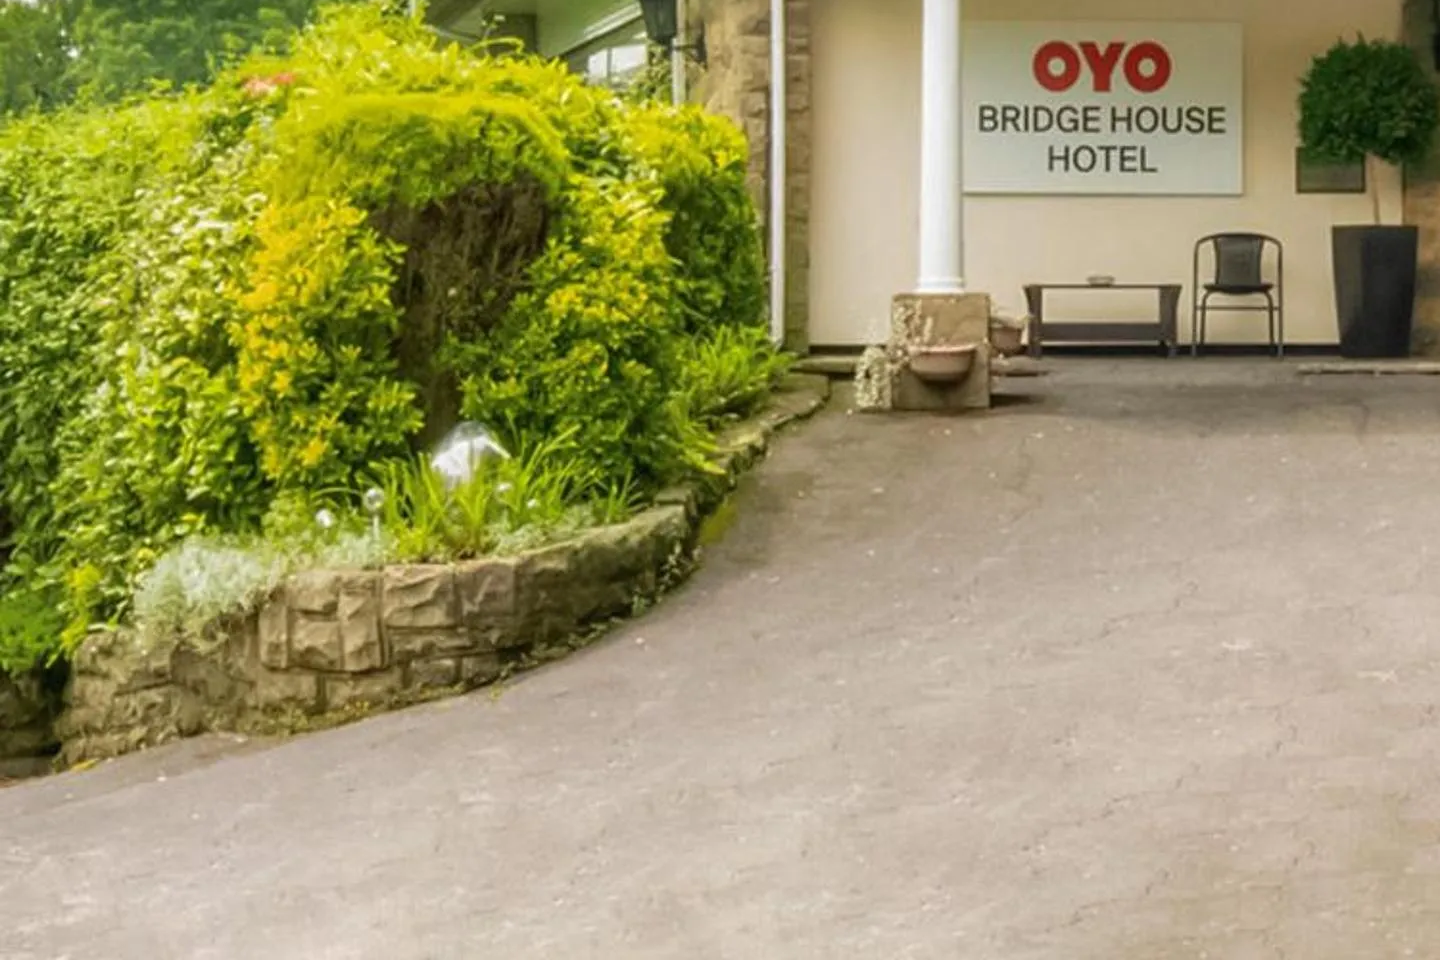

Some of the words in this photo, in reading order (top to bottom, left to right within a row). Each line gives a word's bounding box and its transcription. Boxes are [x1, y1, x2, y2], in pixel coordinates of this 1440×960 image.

[1033, 41, 1171, 92] OYO
[978, 105, 1100, 133] BRIDGE
[1110, 106, 1226, 134] HOUSE
[1048, 145, 1157, 172] HOTEL
